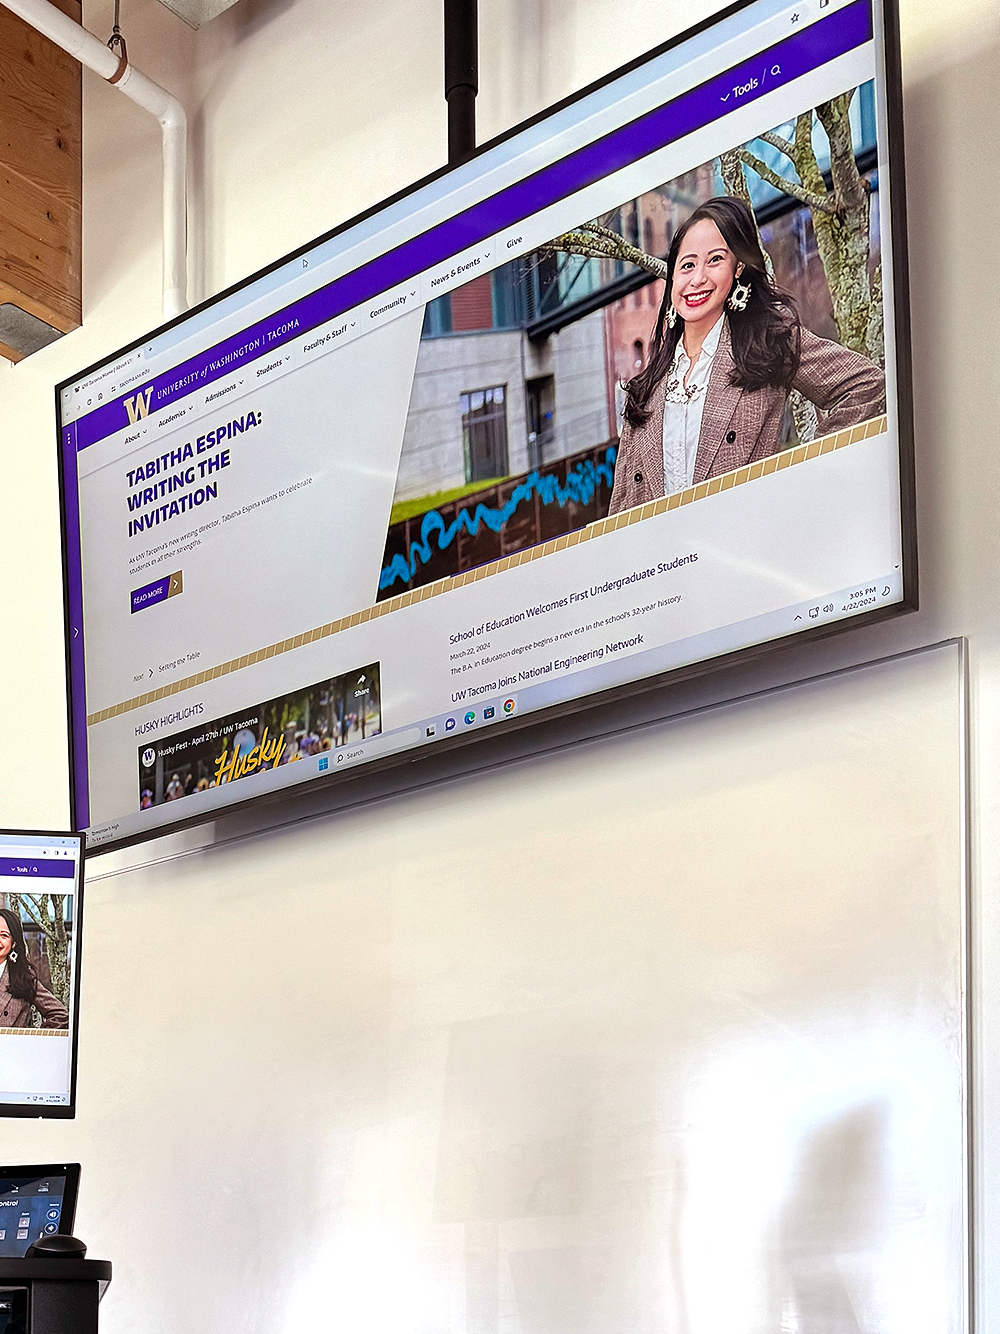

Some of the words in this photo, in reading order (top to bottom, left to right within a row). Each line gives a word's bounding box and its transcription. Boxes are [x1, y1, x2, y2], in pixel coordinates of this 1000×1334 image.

[732, 77, 758, 97] Tools
[506, 236, 522, 248] Give
[431, 273, 449, 287] News
[450, 269, 456, 277] &
[457, 257, 480, 274] Events
[369, 295, 406, 318] Community
[303, 337, 325, 352] Faculty
[326, 333, 331, 341] &
[331, 324, 347, 338] Staff
[157, 370, 199, 399] UNIVERSITY
[200, 365, 208, 378] of
[209, 338, 259, 371] WASHINGTON
[267, 318, 299, 341] TACOMA
[256, 359, 282, 377] Students
[204, 383, 236, 403] Admissions
[123, 386, 154, 424] W
[158, 409, 186, 427] Academics
[124, 432, 140, 444] About
[126, 442, 193, 487] TABITHA
[196, 411, 261, 454] ESPINA:
[126, 466, 195, 512] WRITING
[198, 448, 230, 478] THE
[128, 481, 217, 537] INVITATION
[180, 528, 198, 541] writing
[199, 519, 220, 533] director,
[221, 509, 241, 522] Tabitha
[242, 501, 260, 513] Espina
[260, 493, 277, 504] wants
[286, 477, 312, 494] celebrate
[129, 561, 150, 575] students
[133, 593, 147, 604] READ
[148, 586, 162, 598] MORE
[449, 627, 474, 644] School
[476, 623, 484, 635] of
[486, 612, 525, 632] Education
[526, 597, 568, 617] Welcomes
[569, 590, 588, 603] First
[590, 568, 655, 596] Undergraduate
[657, 553, 698, 574] Students
[841, 596, 876, 611] 4/22/2024
[850, 590, 863, 600] 3:05
[864, 586, 876, 594] PM
[481, 651, 510, 665] Education
[511, 644, 532, 655] degree
[533, 636, 553, 648] begins
[559, 630, 573, 639] new
[574, 626, 584, 634] era
[593, 620, 604, 628] the
[605, 611, 630, 625] school's
[631, 602, 656, 616] 32-year
[657, 595, 682, 607] history.
[158, 661, 176, 672] Setting
[176, 657, 185, 665] the
[186, 651, 200, 660] Table
[450, 650, 466, 660] March
[466, 647, 475, 655] 22,
[476, 642, 490, 652] 2024
[451, 689, 466, 702] UW
[468, 682, 496, 696] Tacoma
[497, 675, 517, 689] Joins
[518, 661, 552, 681] National
[554, 648, 603, 670] Engineering
[605, 633, 643, 654] Network
[354, 688, 369, 697] Share
[134, 719, 158, 736] HUSKY
[160, 702, 203, 727] HIGHLIGHTS
[157, 746, 175, 757] Husky
[176, 741, 187, 751] Fest
[191, 734, 204, 746] April
[205, 730, 218, 741] 27th
[223, 724, 233, 734] UW
[234, 717, 258, 730] Tacoma
[213, 727, 287, 786] Husky
[346, 749, 363, 759] Search
